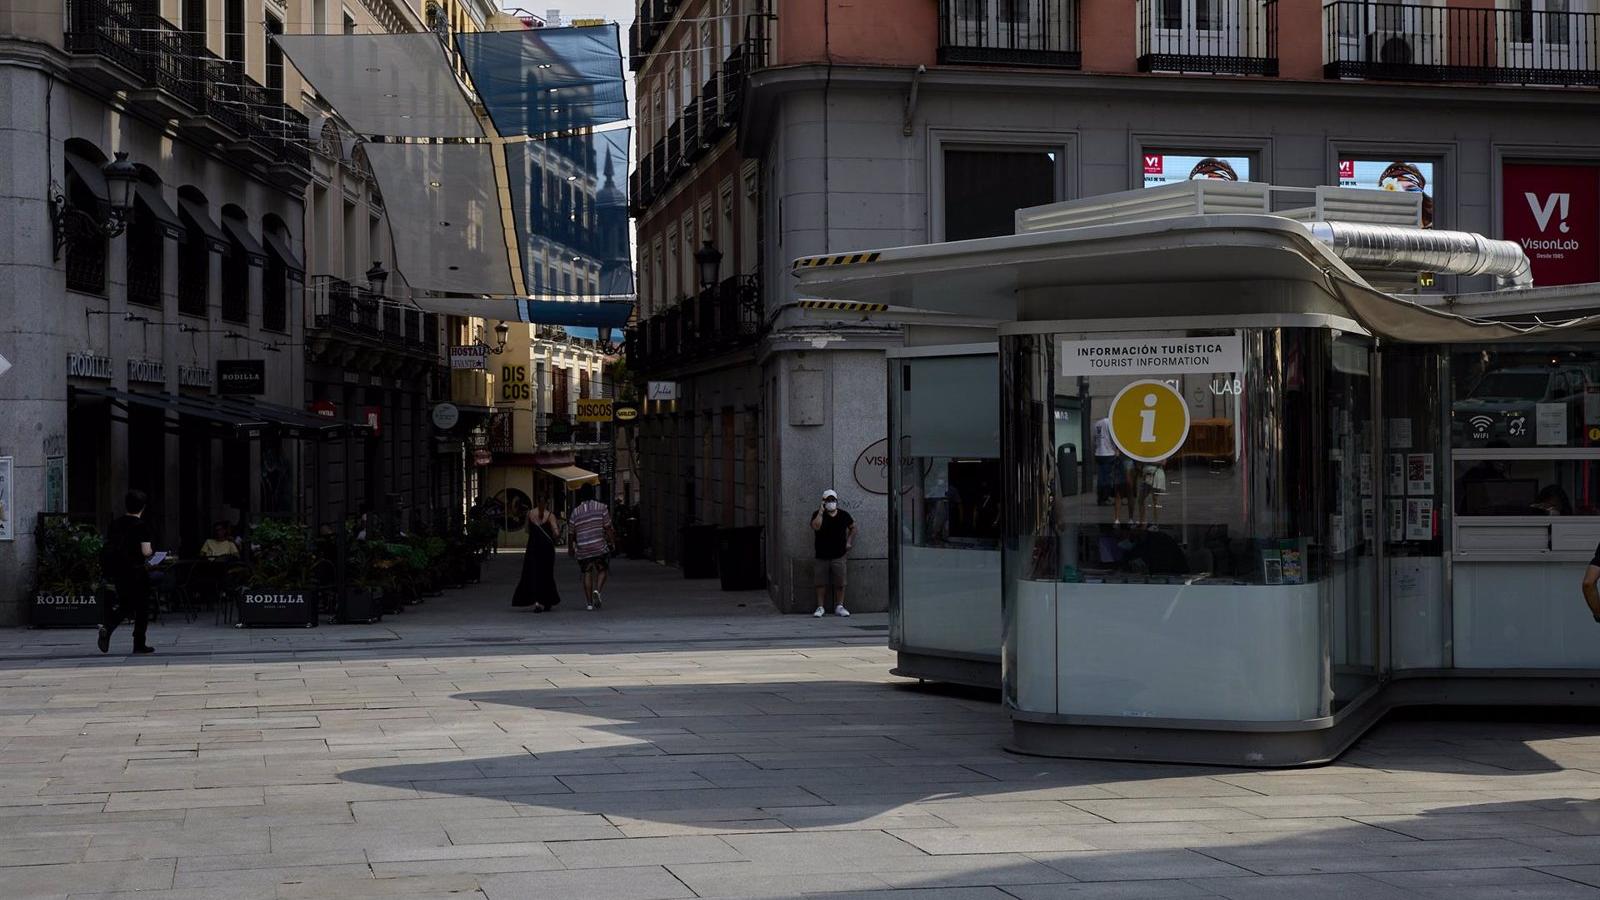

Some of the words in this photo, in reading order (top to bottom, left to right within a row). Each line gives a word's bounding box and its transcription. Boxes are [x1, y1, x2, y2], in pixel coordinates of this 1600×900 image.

[1520, 237, 1579, 250] VisionLab
[452, 347, 484, 356] HOSTAL
[1077, 343, 1158, 356] INFORMACIÓN
[1161, 343, 1223, 355] TURÍSTICA
[1090, 358, 1133, 368] TOURIST
[1136, 356, 1209, 367] INFORMATION
[503, 366, 525, 382] DIS
[503, 384, 530, 399] COS
[577, 404, 612, 417] DISCOS
[36, 595, 97, 605] RODILLA
[245, 594, 304, 604] RODILLA
